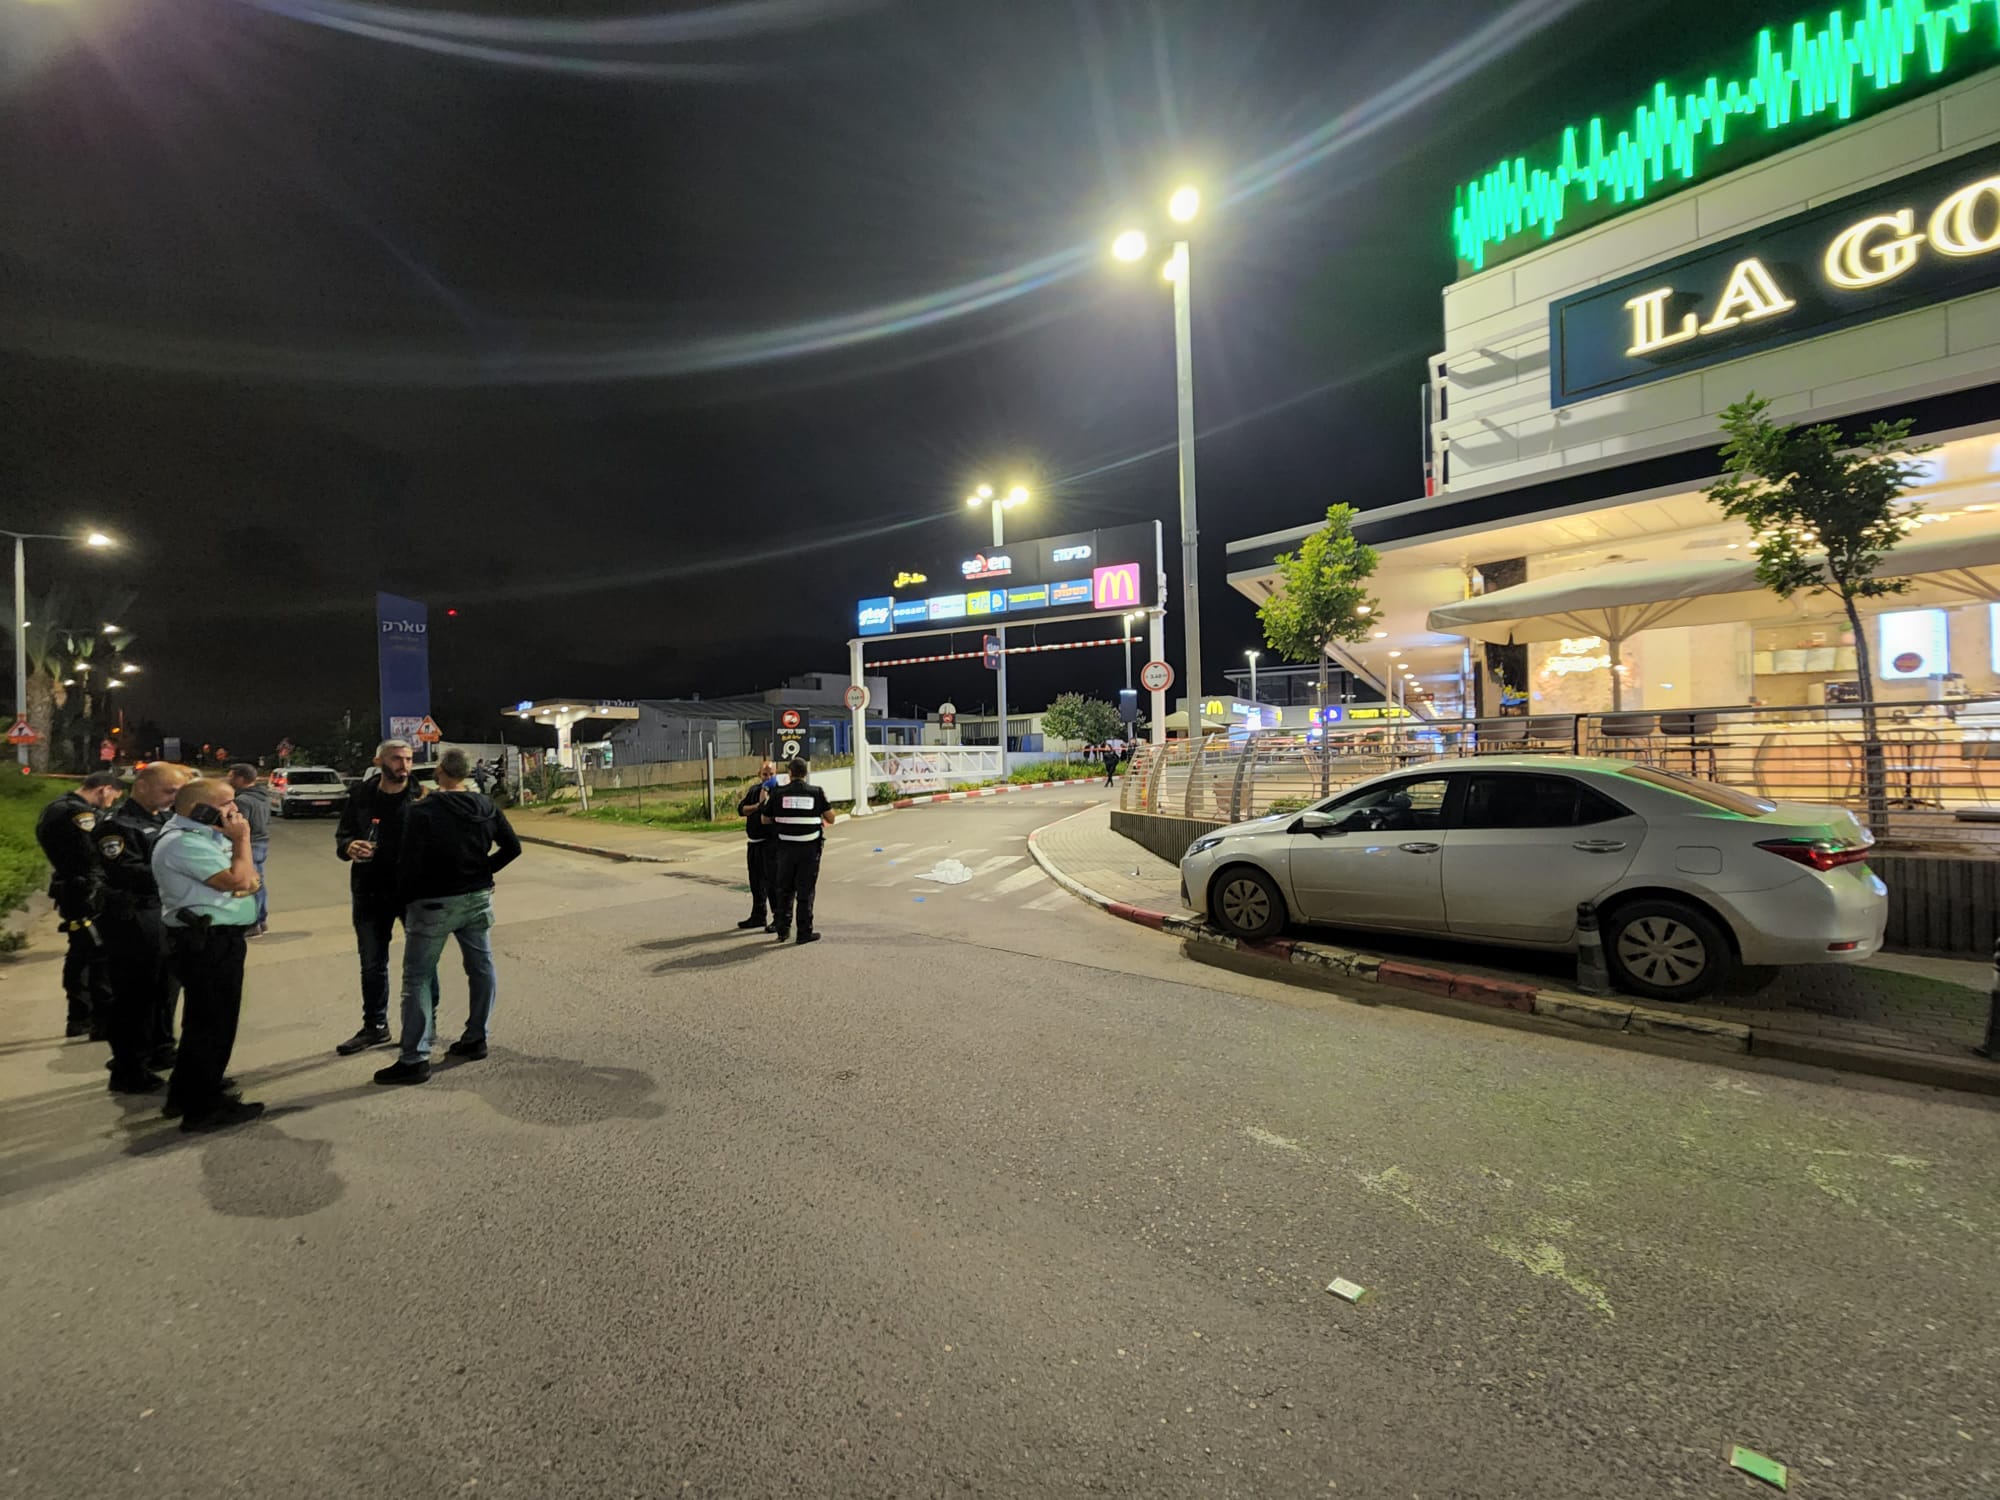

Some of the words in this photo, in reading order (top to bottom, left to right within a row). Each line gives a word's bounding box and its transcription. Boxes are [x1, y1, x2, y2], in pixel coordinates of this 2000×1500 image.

[1625, 256, 1797, 358] LA
[1824, 175, 2000, 290] GO
[961, 552, 1012, 575] seven
